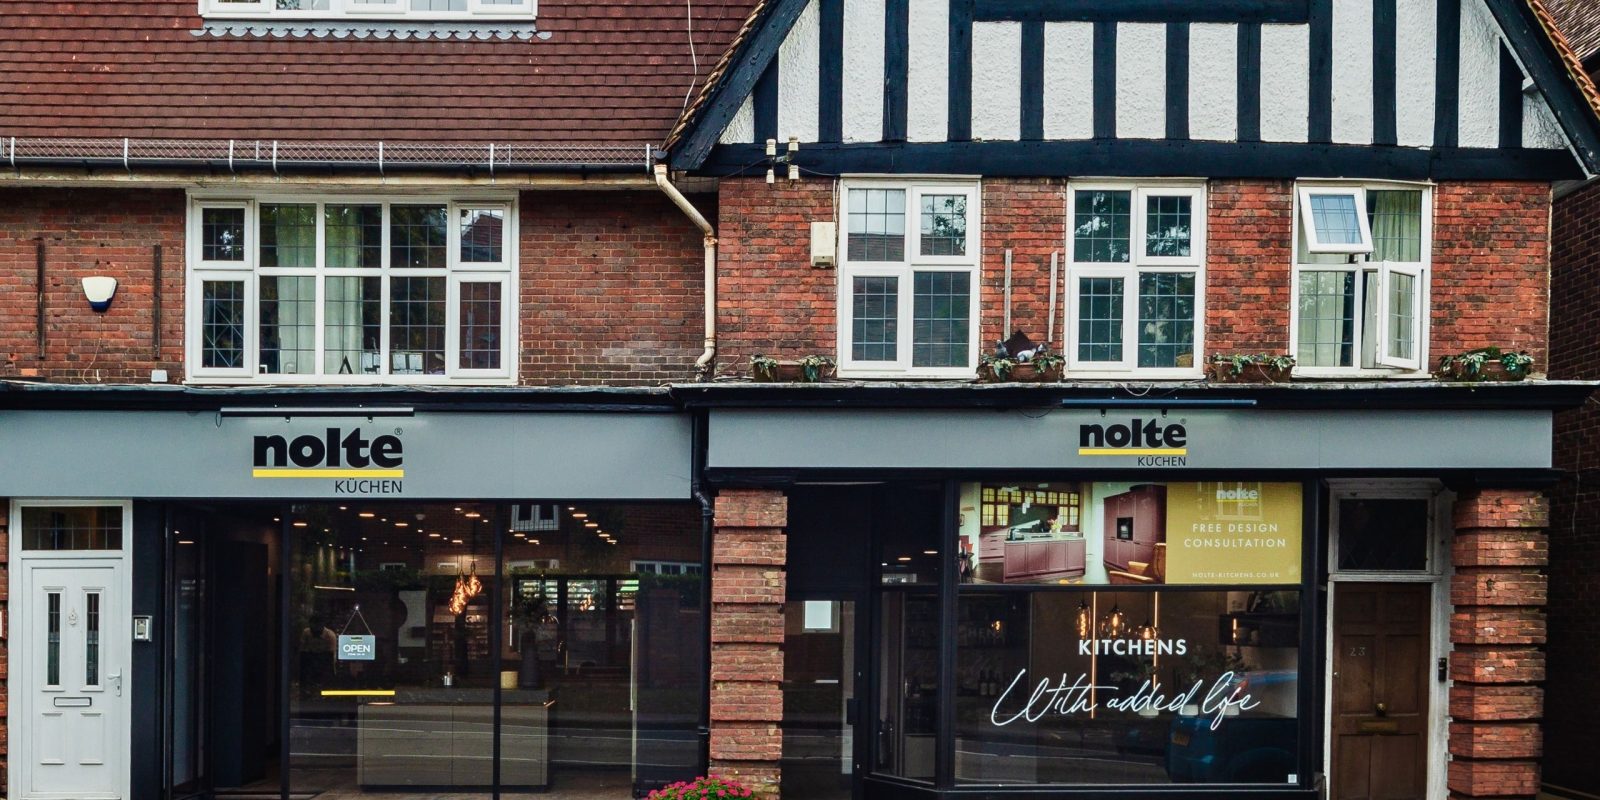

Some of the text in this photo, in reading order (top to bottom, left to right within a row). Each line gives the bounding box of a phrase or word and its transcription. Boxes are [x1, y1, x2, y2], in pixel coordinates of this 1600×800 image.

[1137, 454, 1186, 467] KÜCHEN
[335, 478, 403, 493] KÜCHEN
[1216, 488, 1258, 500] nolte
[1192, 523, 1279, 533] FREE DESIGN
[1184, 538, 1286, 548] CONSULTATION
[343, 644, 371, 653] OPEN
[1078, 639, 1187, 656] KITCHENS
[1350, 647, 1366, 657] 23
[991, 668, 1261, 731] With added life
